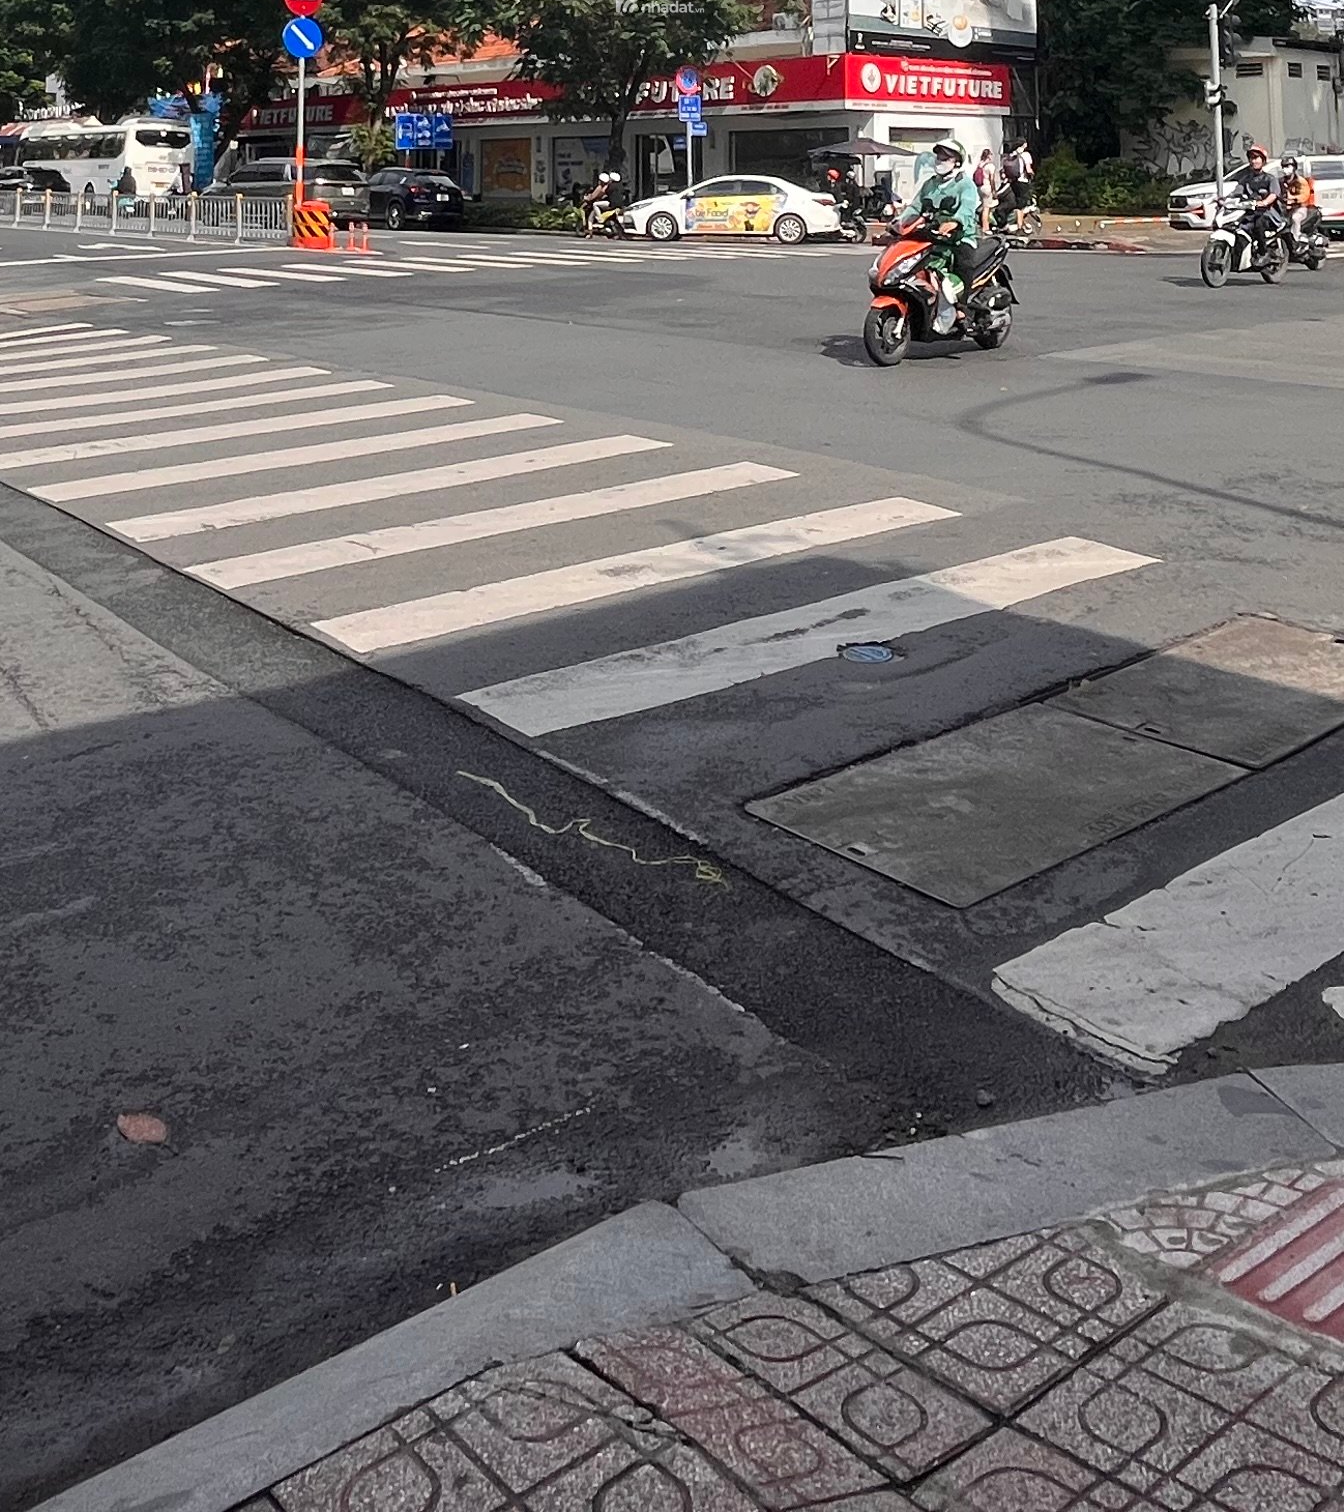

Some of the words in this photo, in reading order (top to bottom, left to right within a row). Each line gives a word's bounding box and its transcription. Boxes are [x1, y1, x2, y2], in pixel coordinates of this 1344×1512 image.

[635, 75, 735, 105] FUTRE
[885, 74, 1003, 99] VIETFUTURE
[252, 104, 334, 125] IETFUURE
